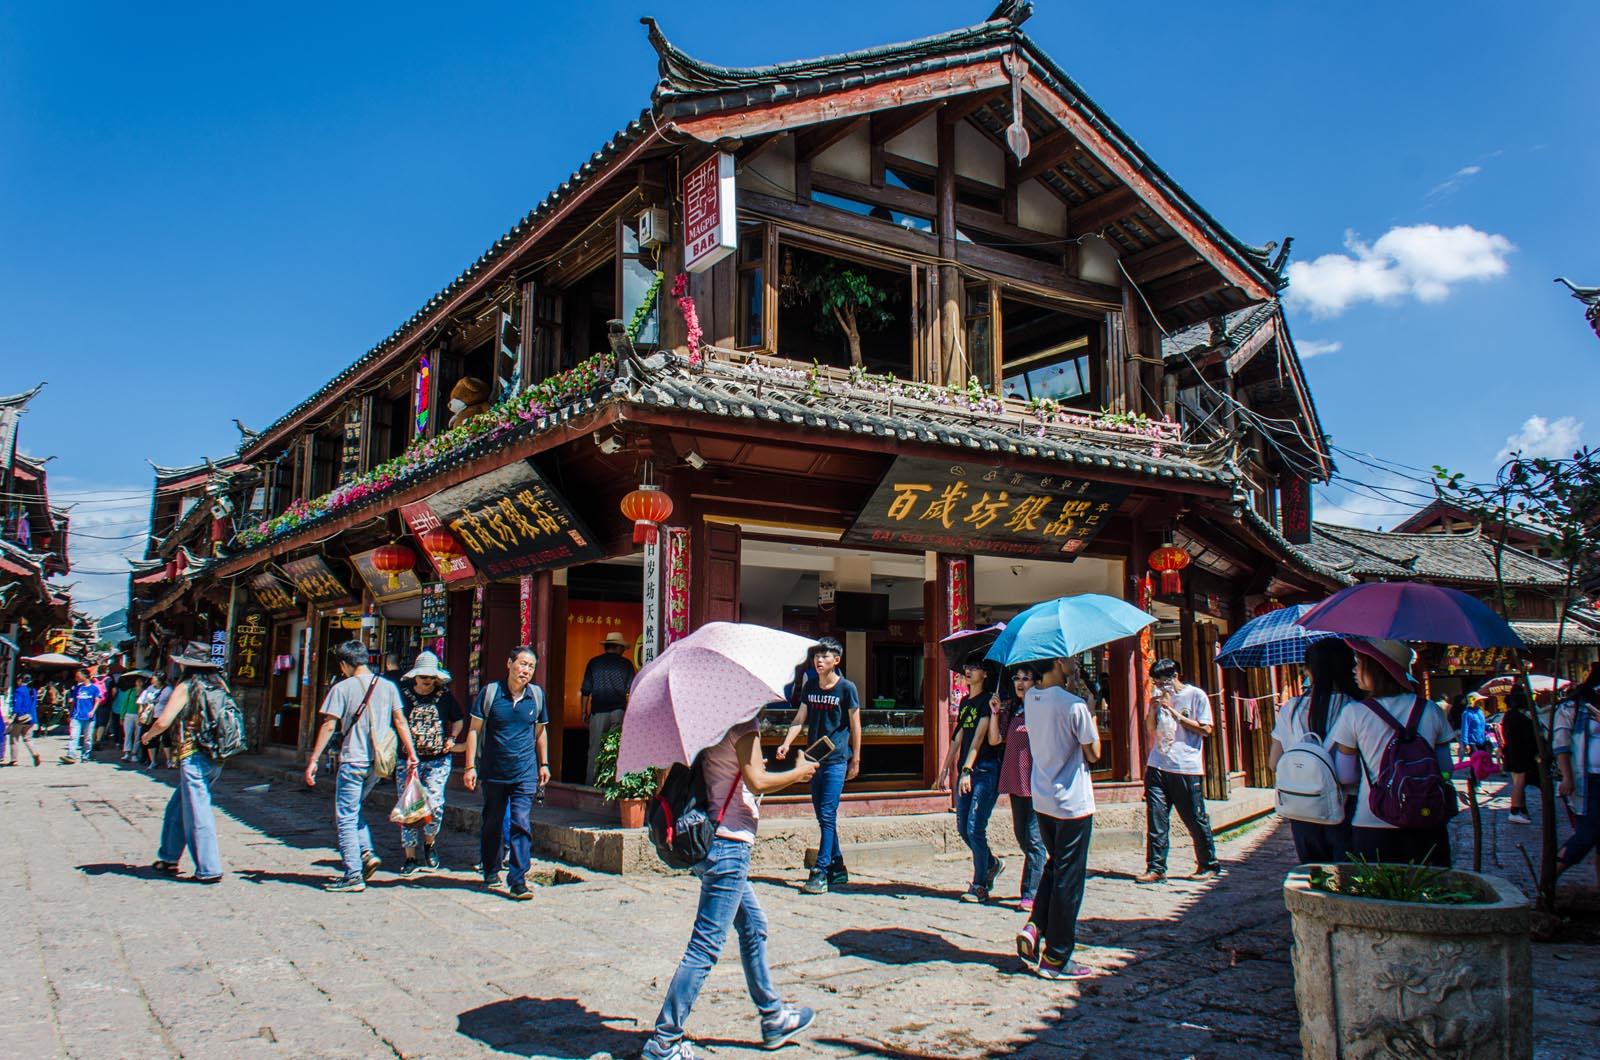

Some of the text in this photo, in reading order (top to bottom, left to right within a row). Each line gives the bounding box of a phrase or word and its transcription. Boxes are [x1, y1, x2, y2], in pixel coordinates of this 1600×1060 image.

[689, 214, 717, 240] MAGPIE
[693, 234, 715, 256] BAR
[872, 530, 895, 542] BAI
